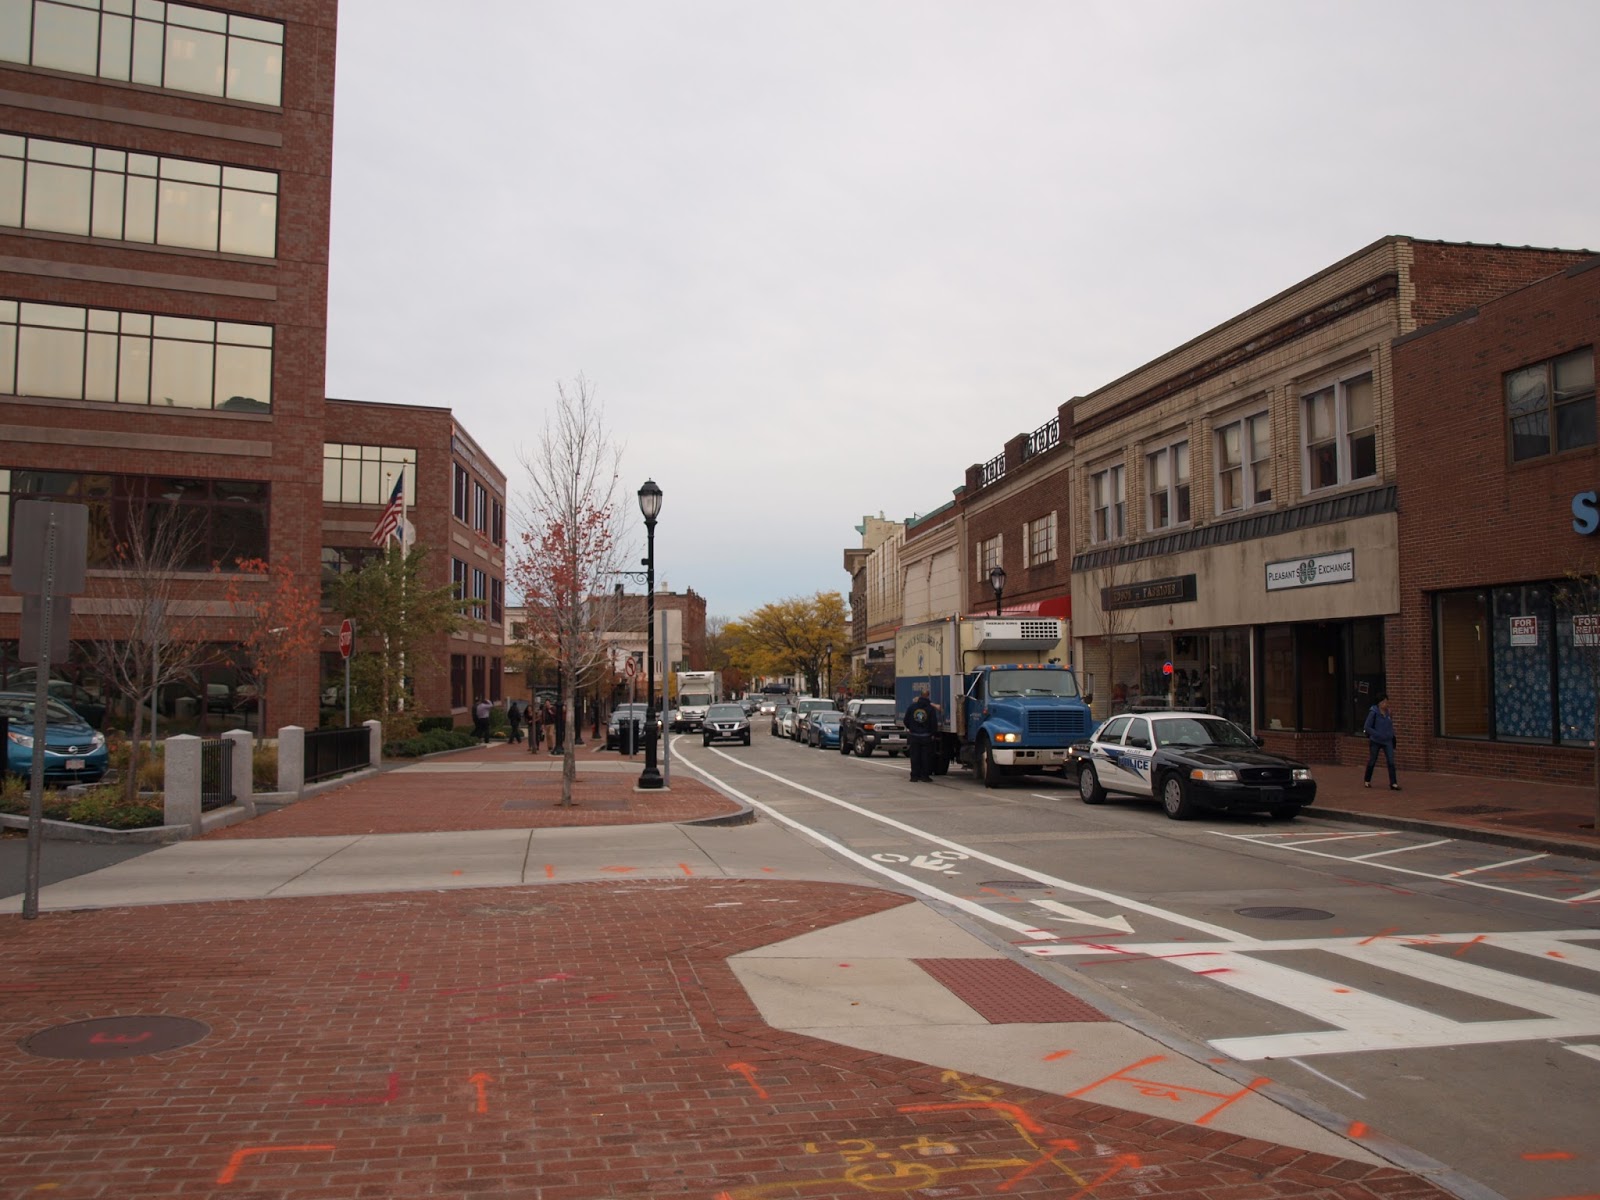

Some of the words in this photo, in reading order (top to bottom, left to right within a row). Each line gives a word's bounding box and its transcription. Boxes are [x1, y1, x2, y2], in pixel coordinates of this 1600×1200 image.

[1268, 570, 1295, 582] PLEASANT
[1318, 561, 1351, 575] EXCHANGE
[1514, 619, 1532, 627] FOR
[1578, 617, 1598, 626] FOR
[1512, 626, 1535, 635] RENT
[341, 631, 352, 647] STOP
[1118, 757, 1149, 771] POLICE
